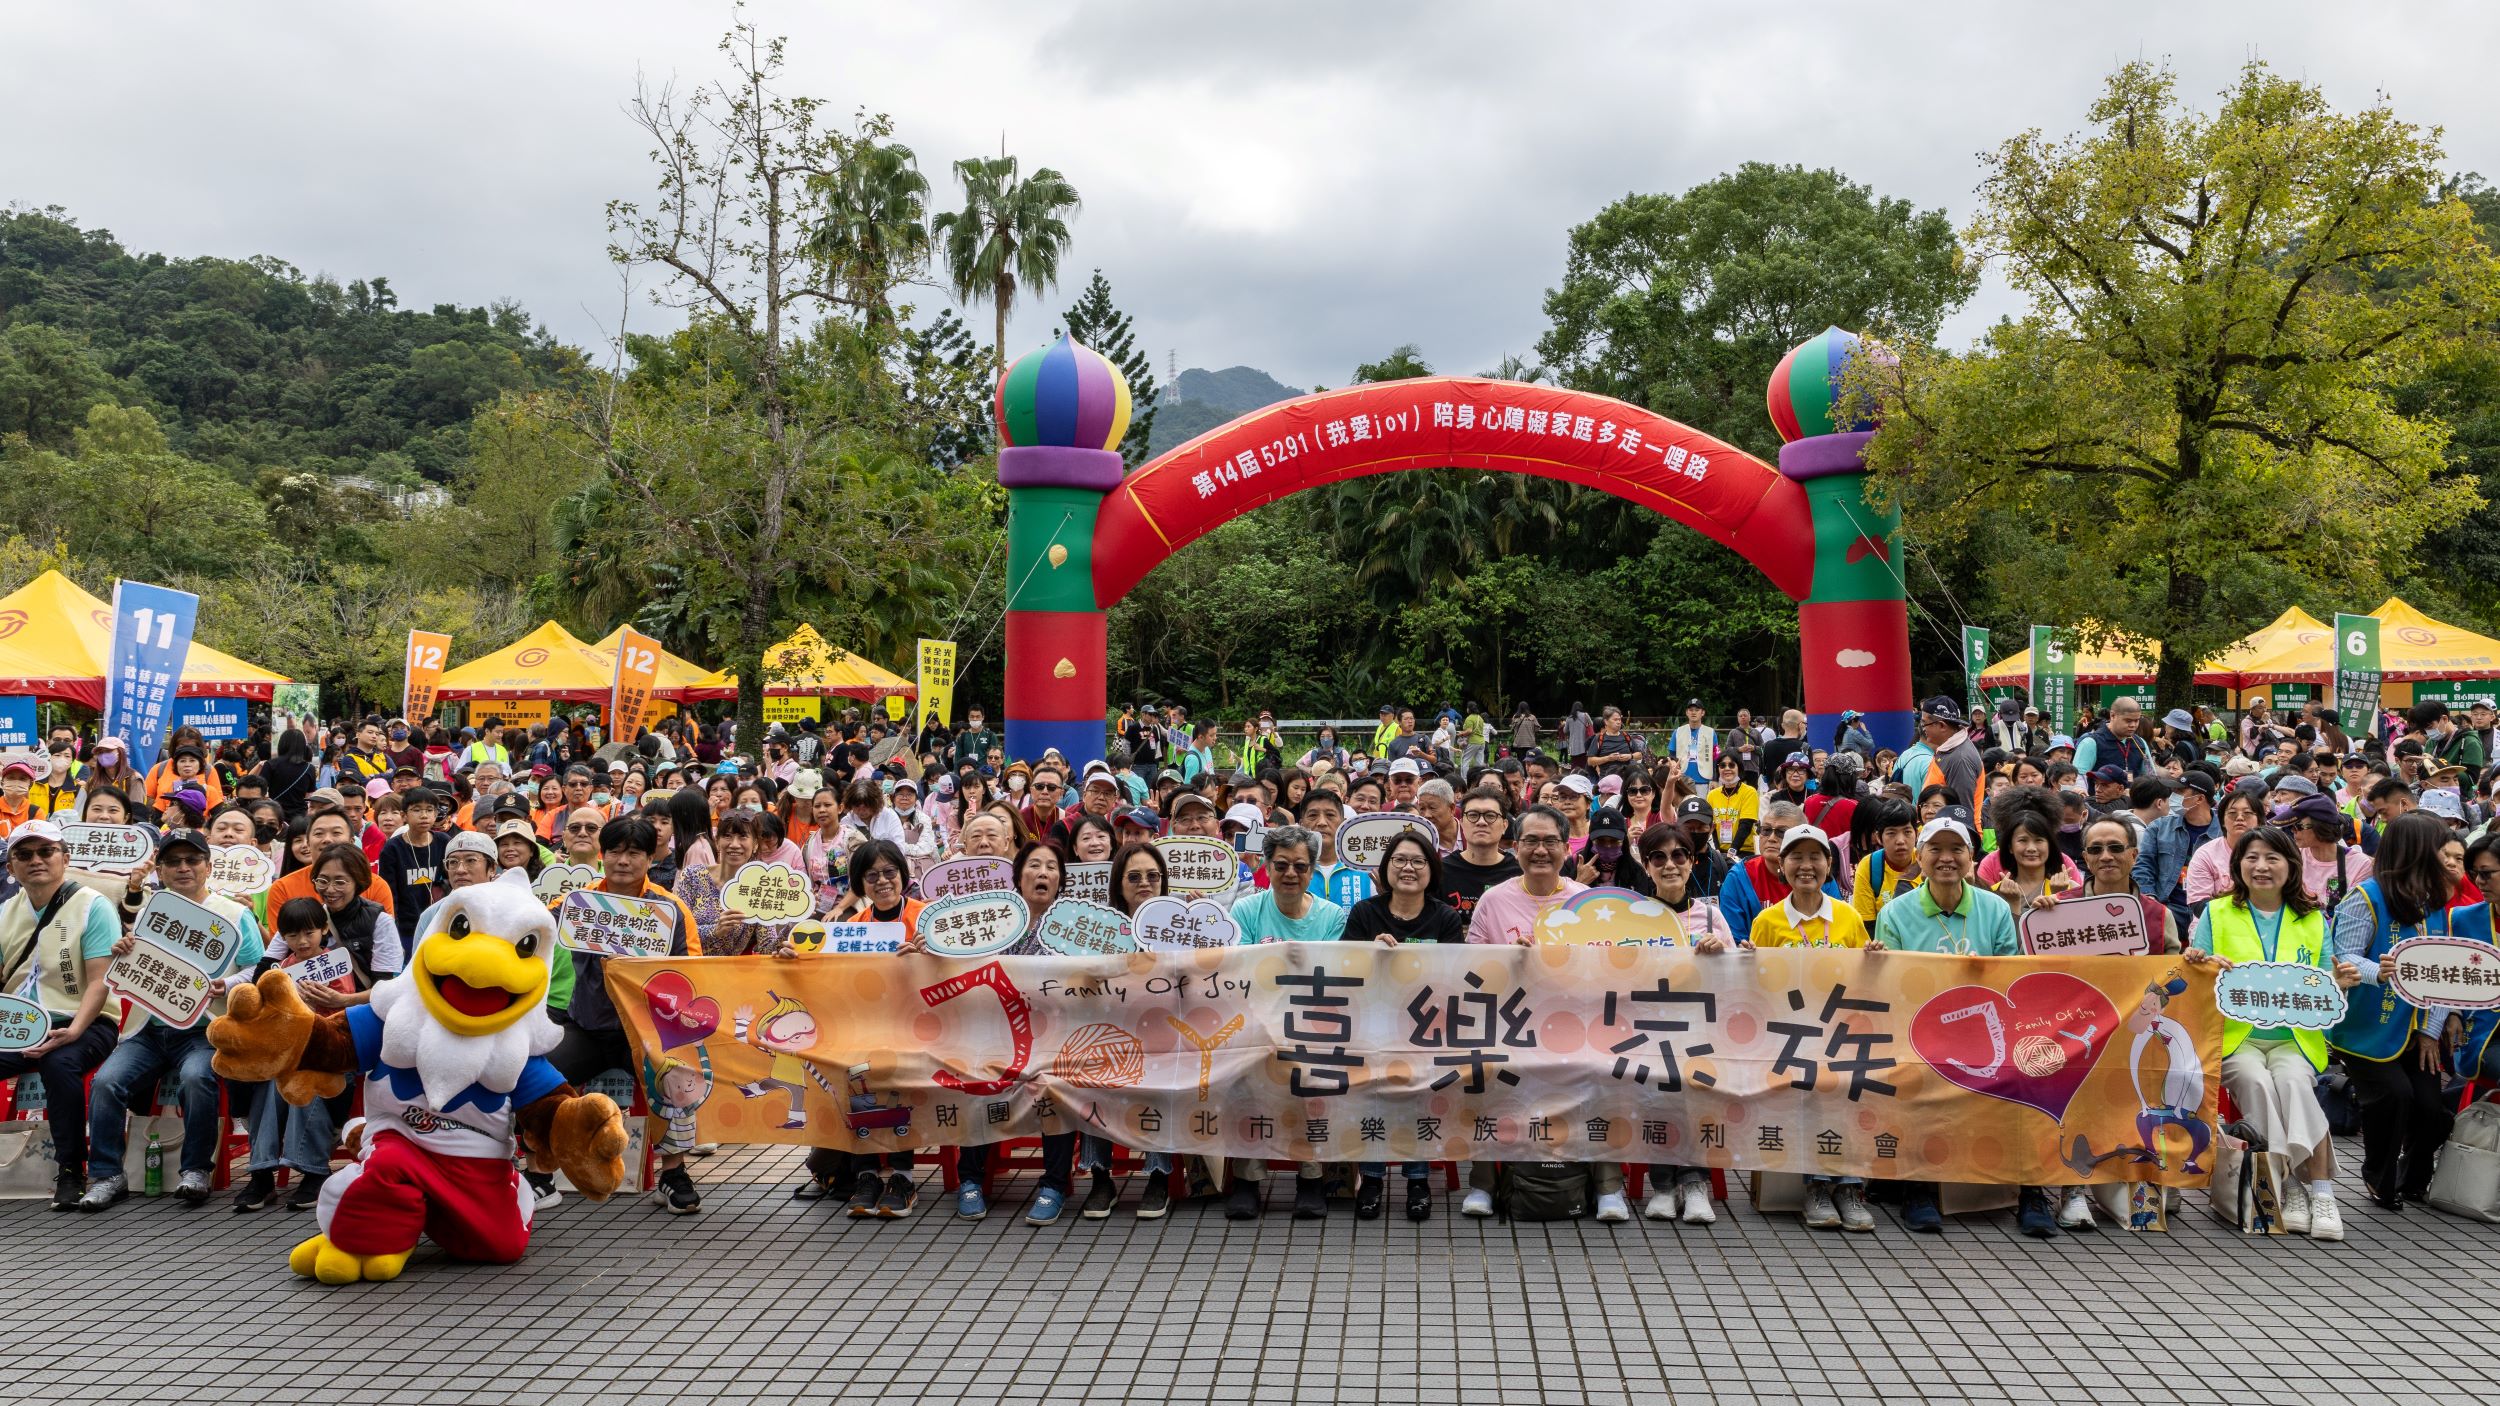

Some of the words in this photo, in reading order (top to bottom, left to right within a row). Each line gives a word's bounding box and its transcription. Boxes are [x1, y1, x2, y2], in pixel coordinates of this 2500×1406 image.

[133, 608, 176, 649] 11
[1974, 640, 1984, 661] 5
[2046, 641, 2065, 664] 5
[2347, 631, 2367, 655] 6
[413, 645, 443, 670] 12
[624, 646, 655, 675] 12
[2137, 685, 2145, 694] 5
[2453, 682, 2462, 692] 6
[203, 700, 215, 712] 11
[504, 701, 517, 710] 12
[777, 697, 789, 706] 13
[1688, 801, 1700, 812] C
[88, 830, 118, 843] 台北
[213, 858, 241, 870] 台北
[1167, 849, 1212, 864] 台北市
[212, 870, 255, 883] 扶輪社
[759, 875, 784, 888] 台北
[946, 865, 991, 882] 台北市
[1065, 871, 1109, 887] 台北市
[738, 884, 801, 902] 無限大網路
[935, 876, 1008, 897] 城北扶輪社
[747, 899, 785, 911] 扶輪社
[565, 905, 659, 934] 嘉里國際物流
[934, 904, 1013, 934] 文教基金會
[1074, 915, 1119, 940] 台北市
[1170, 914, 1203, 932] 台北
[146, 911, 225, 961] 信創集團
[573, 926, 667, 953] 嘉里大榮物流
[833, 926, 867, 937] 台北市
[959, 925, 996, 946] 光泉
[2036, 920, 2140, 950] 忠誠扶輪社
[837, 940, 900, 952] 記帳士公會
[304, 953, 331, 973] 全家
[2400, 961, 2500, 987] 東鴻扶輪社
[114, 961, 196, 1014] 股份有限公司
[1039, 979, 1127, 1002] Family
[1145, 975, 1190, 998] Of
[1203, 972, 1251, 999] Joy
[2228, 988, 2335, 1011] 華朋扶輪社
[2015, 1016, 2052, 1032] Family
[2076, 1007, 2096, 1020] Joy
[0, 1025, 30, 1041] 公司
[1275, 966, 1897, 1102] 喜樂家族
[937, 1098, 1900, 1160] 財團法人台北市喜樂家族社會福利基金會
